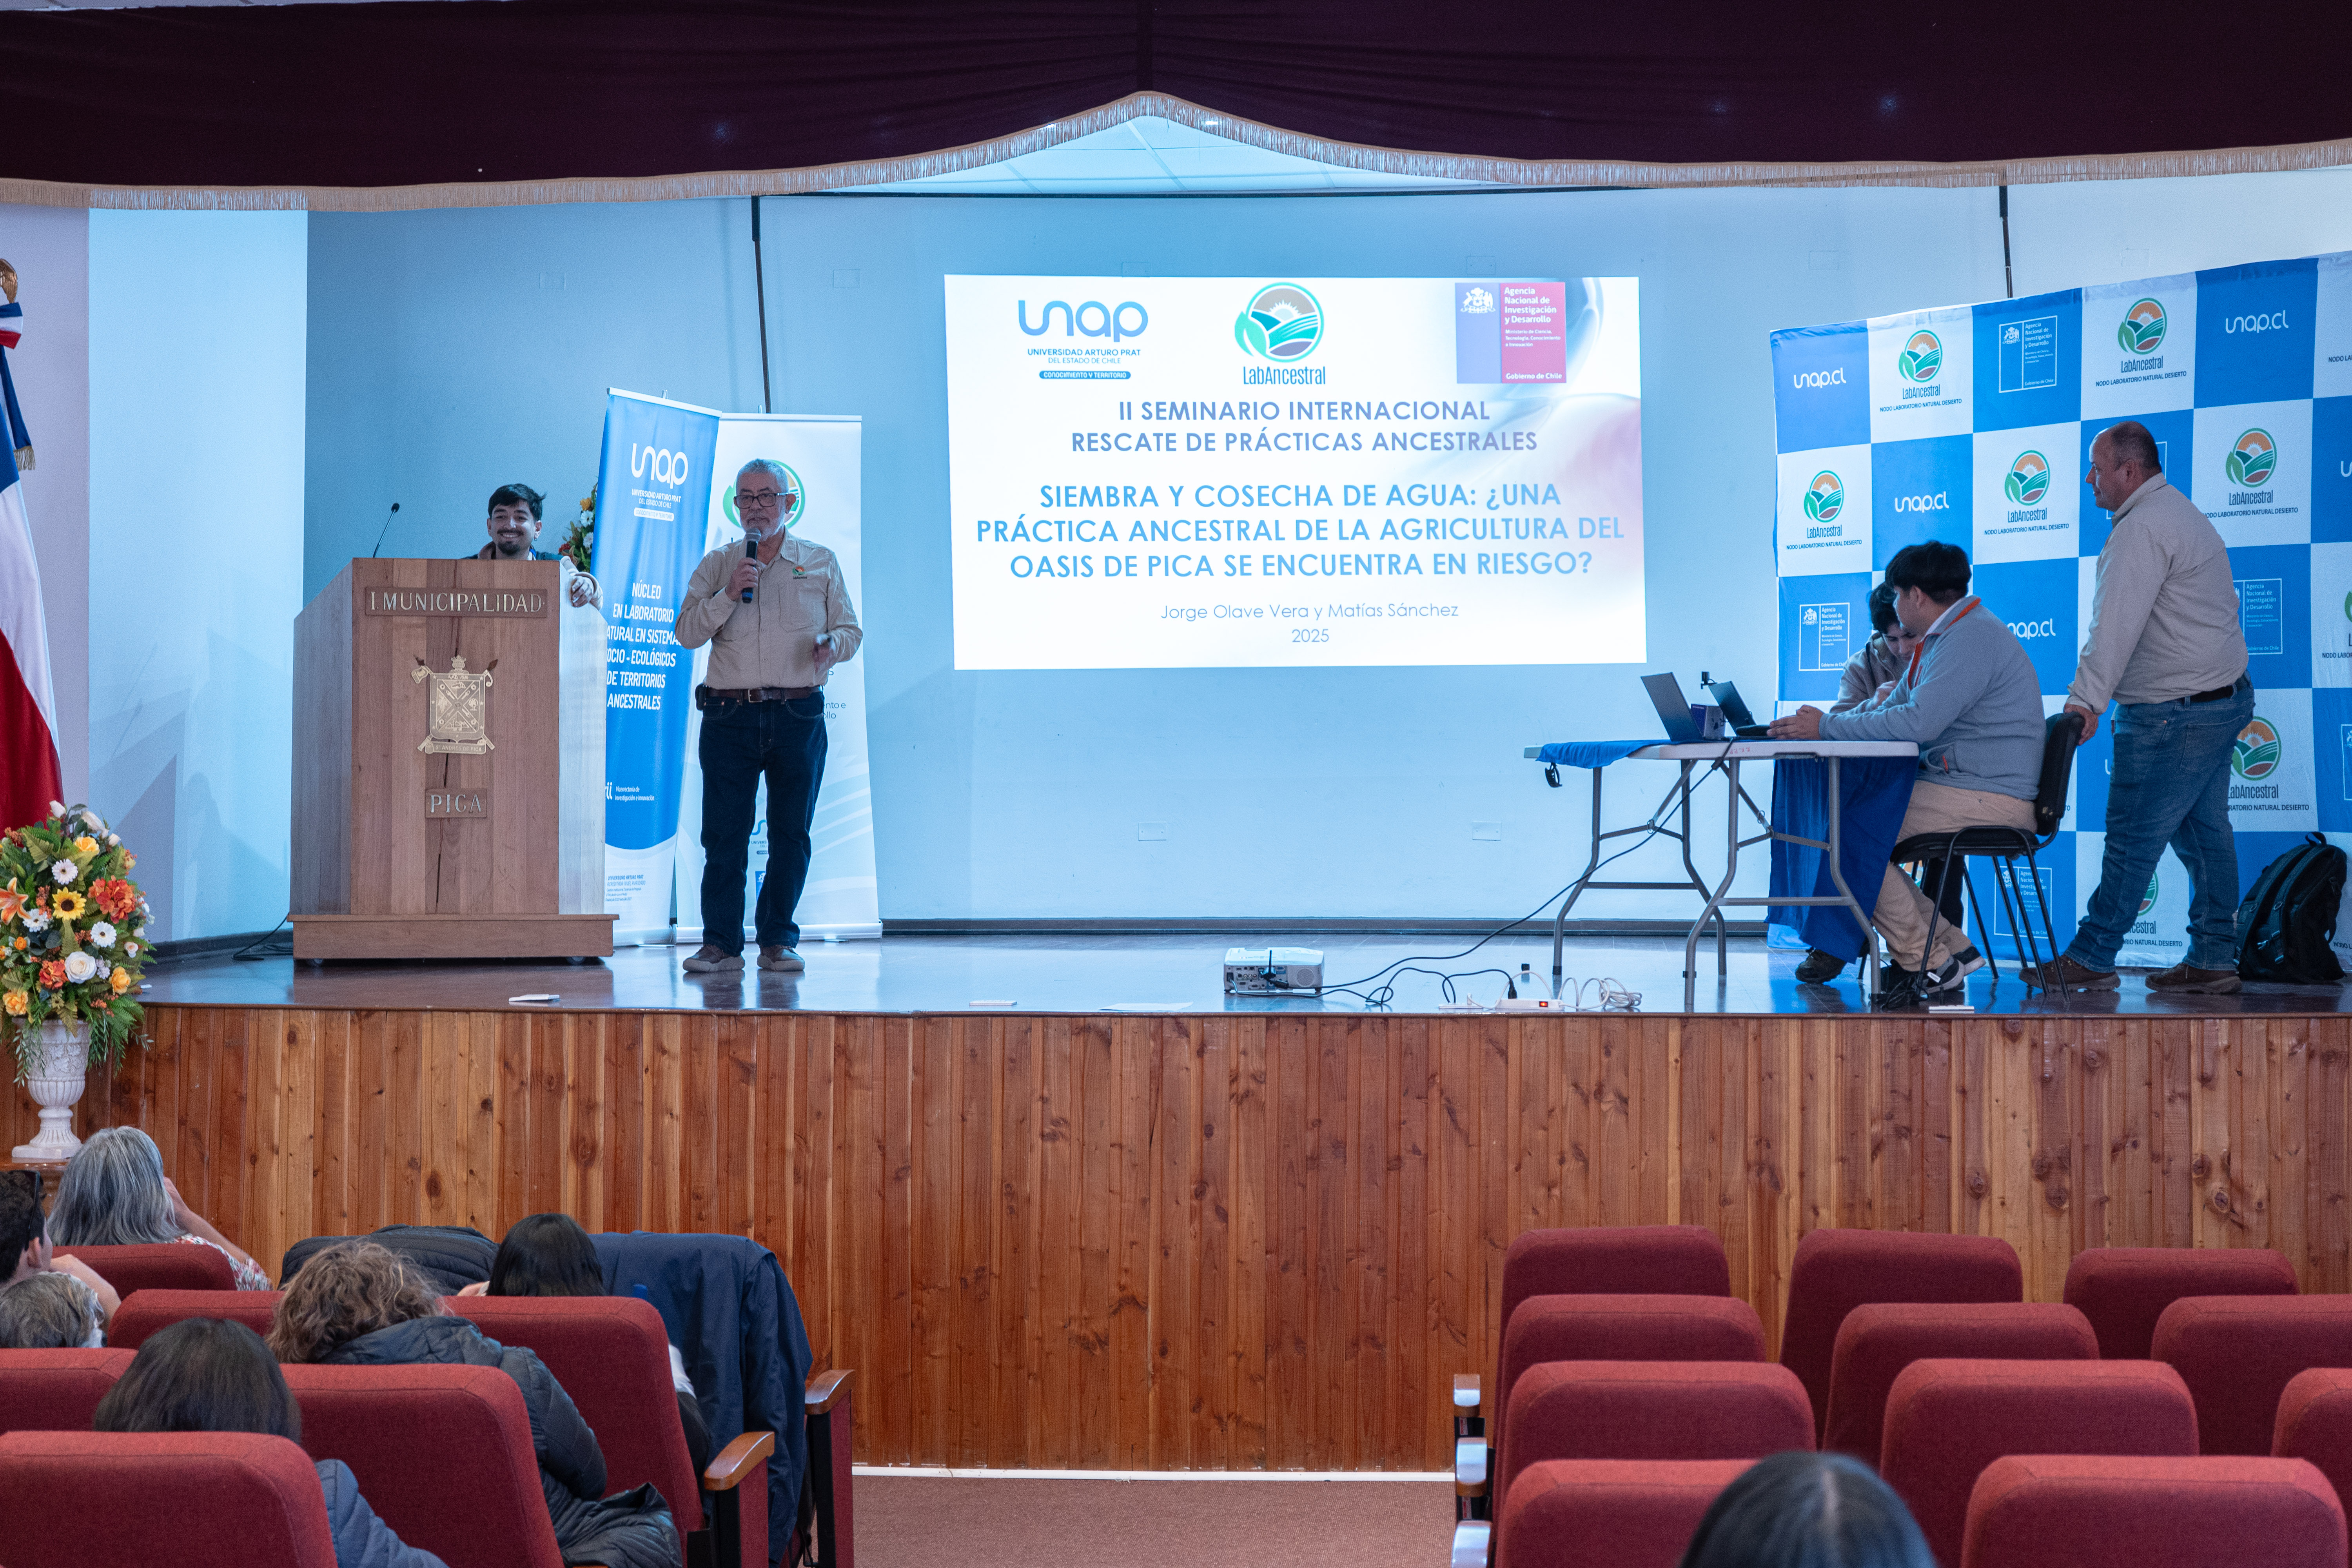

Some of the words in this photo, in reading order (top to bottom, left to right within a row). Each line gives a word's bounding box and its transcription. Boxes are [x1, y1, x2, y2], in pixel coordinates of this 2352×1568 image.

[1504, 287, 1535, 296] Agencia
[1504, 306, 1557, 315] Investigación
[1018, 299, 1149, 343] unap
[2225, 310, 2289, 334] unap.cl
[2025, 333, 2052, 341] Investigación
[2121, 355, 2163, 373] LabAncestral
[1243, 366, 1326, 385] LabAncestral
[1793, 367, 1847, 389] unap.cl
[2111, 376, 2142, 385] LABORATORIO
[1902, 383, 1940, 399] LabAncestral
[1120, 401, 1132, 420] II
[1141, 401, 1280, 420] SEMINARIO
[1289, 401, 1490, 420] INTERNACIONAL
[1072, 432, 1176, 452] RESCATE
[1187, 432, 1216, 452] DE
[1225, 426, 1363, 452] PRÁCTICAS
[1372, 432, 1537, 451] ANCESTRALES
[631, 443, 688, 490] unap
[632, 488, 656, 499] UNIVERSIDAD
[656, 492, 671, 501] ARTURO
[671, 495, 682, 503] PRAT
[1040, 485, 1159, 508] SIEMBRA
[1168, 485, 1184, 507] Y
[1194, 485, 1333, 507] COSECHA
[1343, 485, 1376, 506] DE
[1386, 484, 1476, 506] AGUA:
[1486, 483, 1561, 510] ¿UNA
[1895, 491, 1949, 513] unap.cl
[2229, 490, 2274, 506] LabAncestral
[2007, 507, 2047, 523] LabAncestral
[977, 514, 1119, 542] PRÁCTICA
[1128, 519, 1285, 542] ANCESTRAL
[1295, 519, 1328, 541] DE
[1338, 519, 1370, 541] LA
[1379, 517, 1569, 540] AGRICULTURA
[1579, 517, 1624, 539] DEL
[1807, 524, 1842, 539] LabAncestral
[1010, 555, 1094, 578] OASIS
[1104, 555, 1138, 577] DE
[1148, 555, 1214, 577] PICA
[1223, 554, 1252, 577] SE
[1262, 553, 1423, 576] ENCUENTRA
[1433, 553, 1466, 575] EN
[1477, 551, 1593, 575] RIESGO?
[632, 579, 662, 600] NÚCLEO
[383, 592, 543, 613] MUNICIPALIDAD
[1161, 605, 1208, 622] Jorge
[1213, 604, 1264, 618] Olave
[1269, 604, 1309, 618] Vera
[1314, 607, 1323, 621] y
[1328, 603, 1383, 617] Matías
[1388, 602, 1459, 617] Sánchez
[612, 603, 623, 619] EN
[624, 604, 674, 623] LABORATORIO
[606, 625, 634, 642] ATURAL
[635, 627, 646, 643] EN
[1291, 628, 1330, 642] 2025
[2007, 618, 2056, 640] nap.cl
[606, 648, 626, 664] OCIO
[630, 647, 677, 668] ECOLÓGICOS
[606, 670, 619, 686] DE
[620, 671, 666, 689] TERRITORIOS
[607, 693, 661, 710] ANCESTRALES
[2228, 784, 2279, 799] abAncestral
[430, 793, 482, 814] PICA
